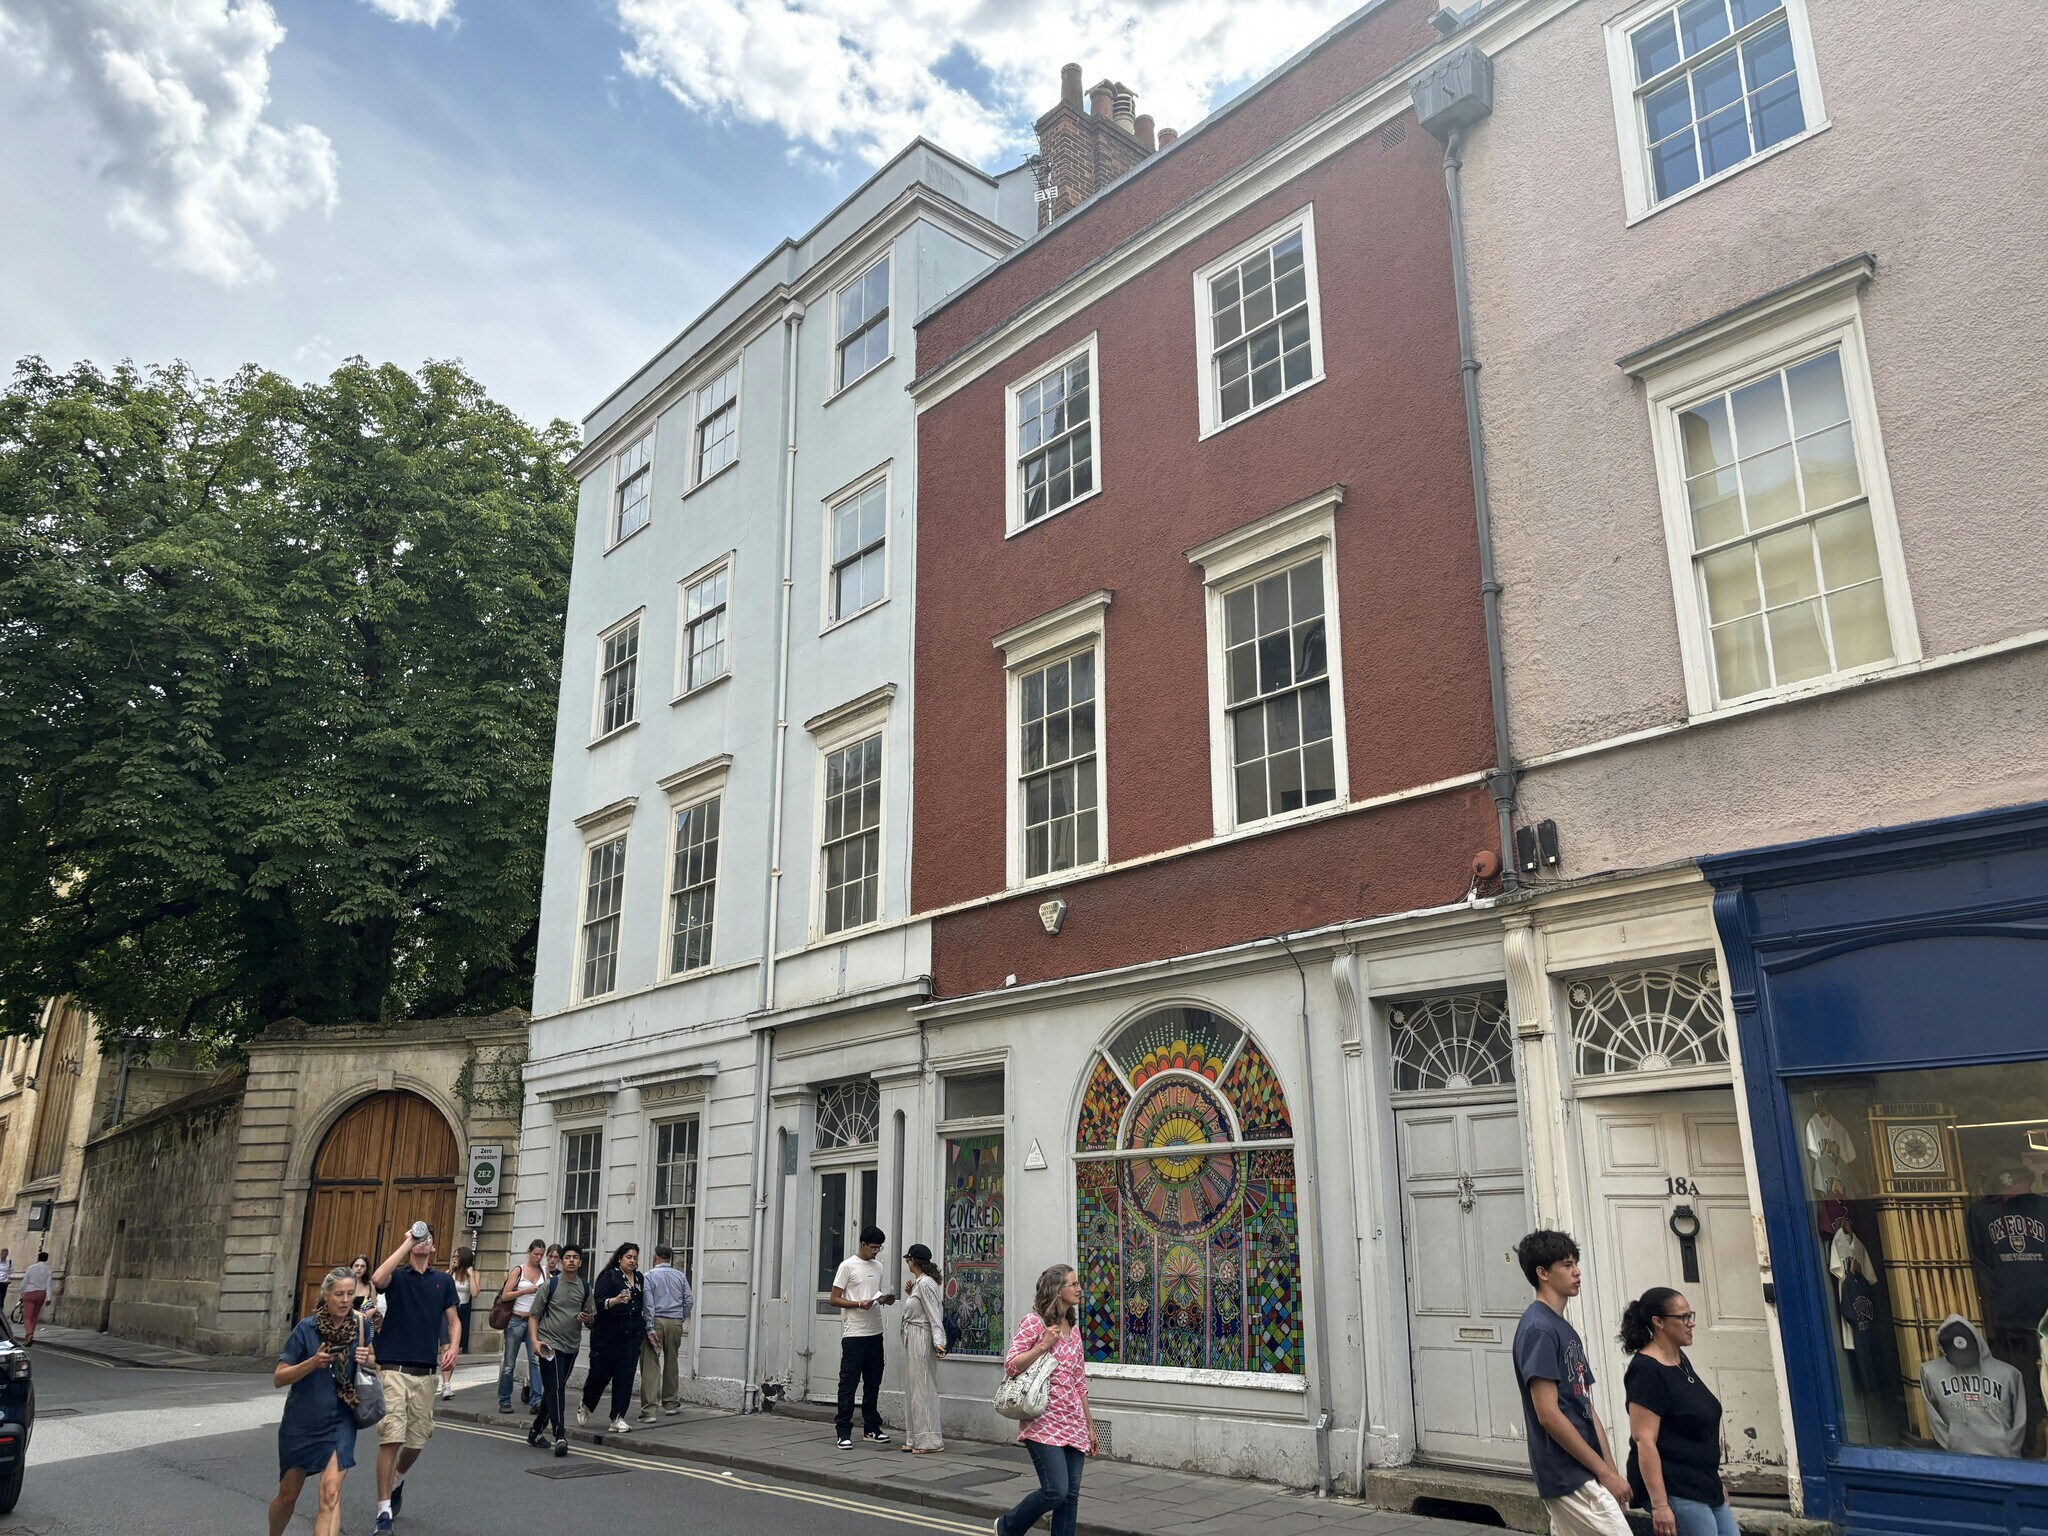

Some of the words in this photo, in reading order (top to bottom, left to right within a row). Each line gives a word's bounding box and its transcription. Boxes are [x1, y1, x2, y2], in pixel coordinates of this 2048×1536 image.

[477, 1170, 492, 1178] ZEZ
[1664, 1176, 1700, 1196] 18A
[948, 1203, 1000, 1228] COVERED
[1988, 1214, 2046, 1244] OXFORD
[951, 1233, 998, 1256] MARKET
[1940, 1375, 2003, 1402] LONDON
